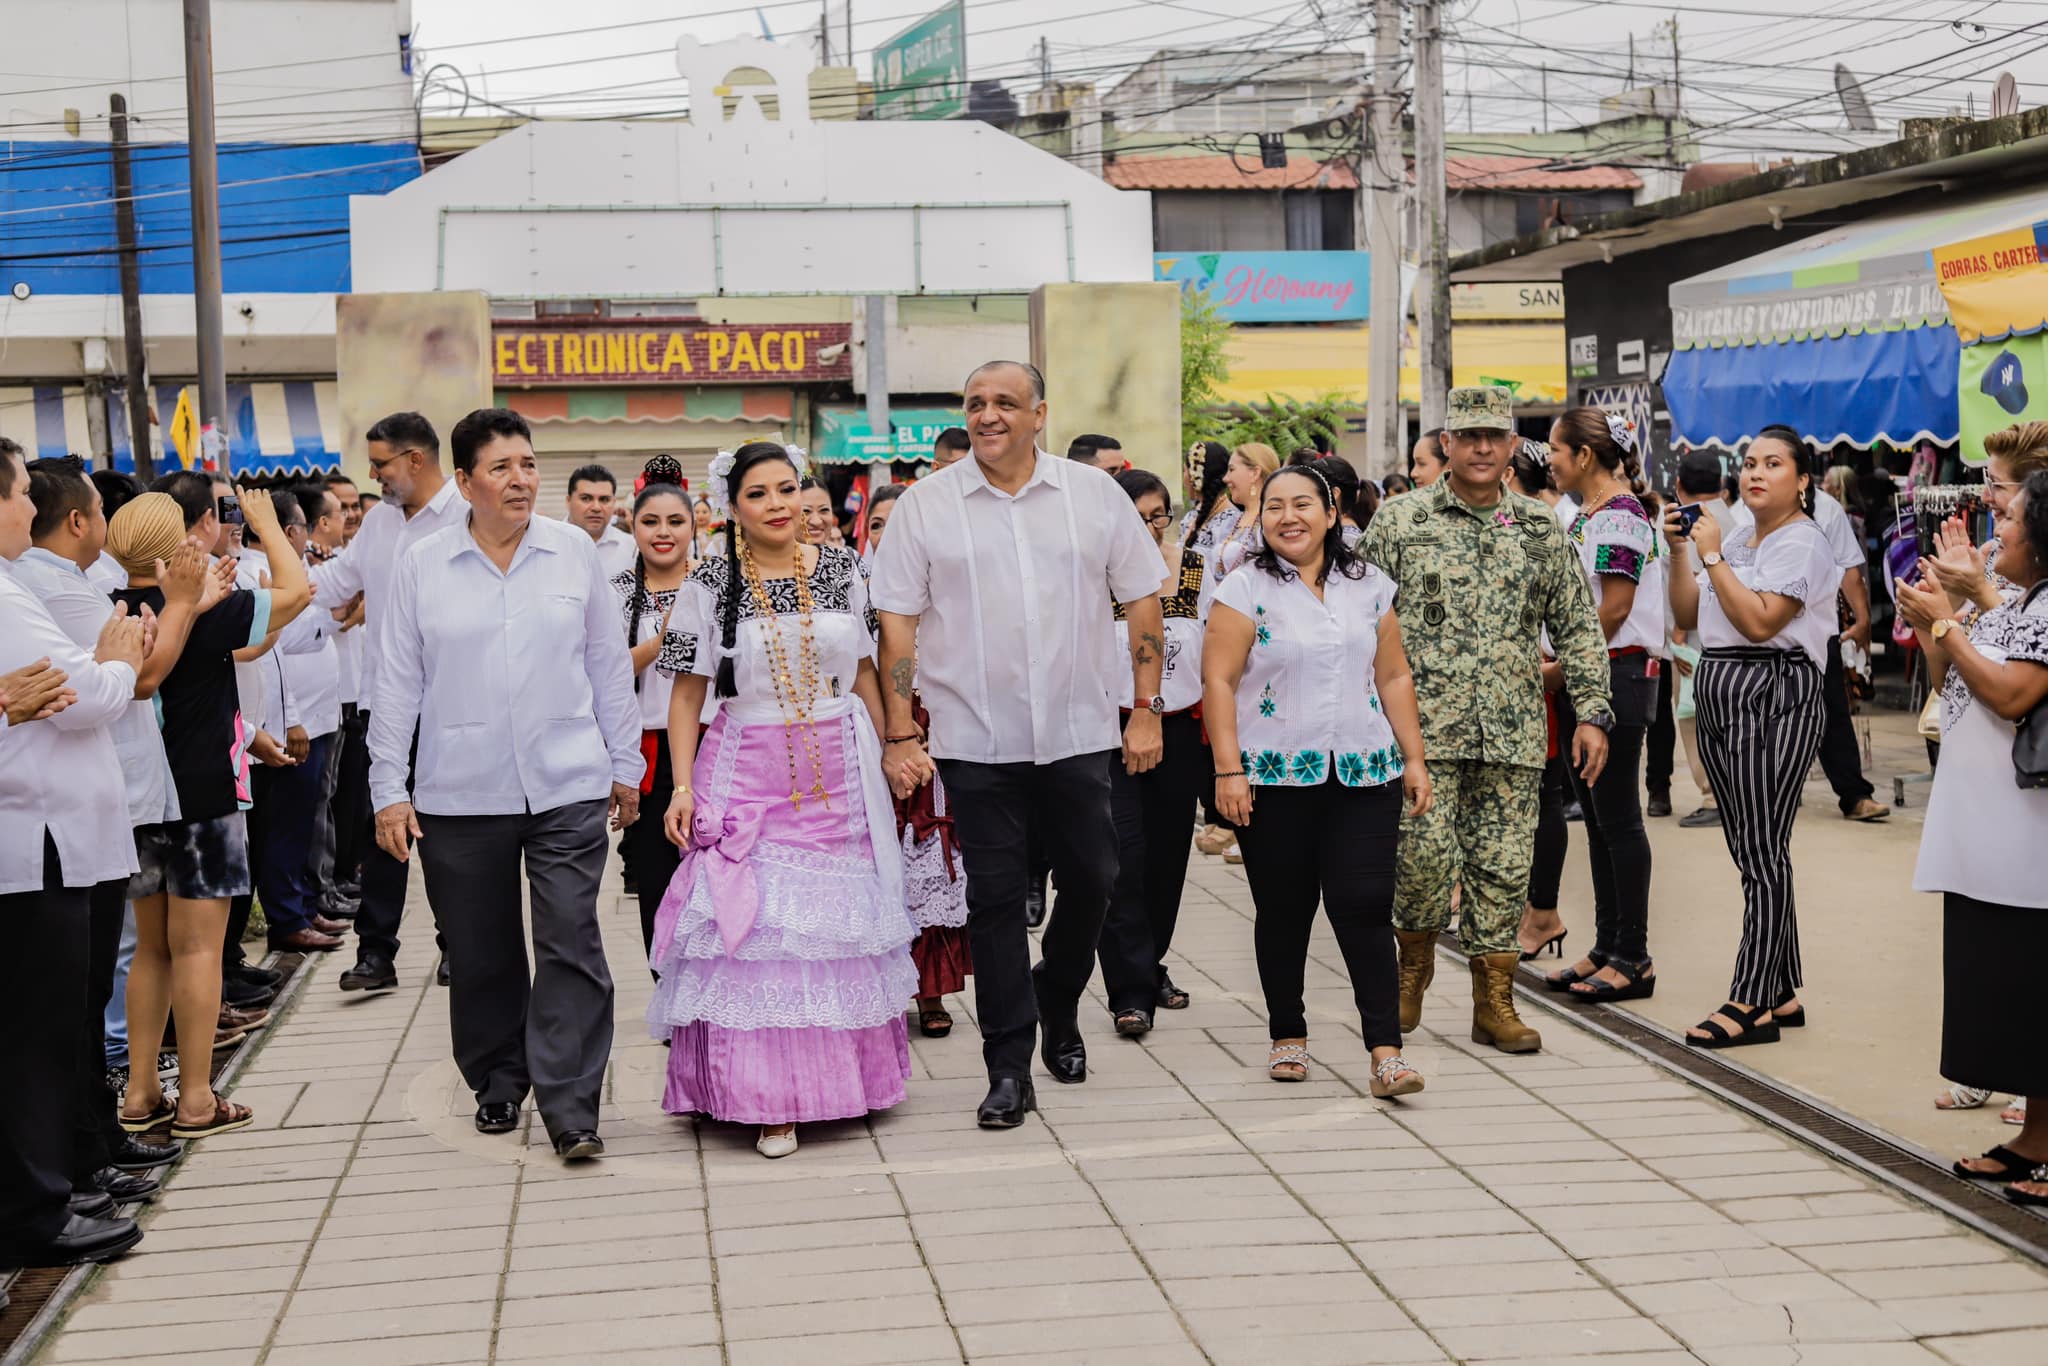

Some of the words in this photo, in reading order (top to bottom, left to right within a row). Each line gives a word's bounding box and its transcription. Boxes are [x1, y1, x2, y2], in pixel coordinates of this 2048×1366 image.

[1519, 289, 1560, 306] SAN
[491, 332, 694, 375] ECTRONICA
[898, 427, 918, 443] EL
